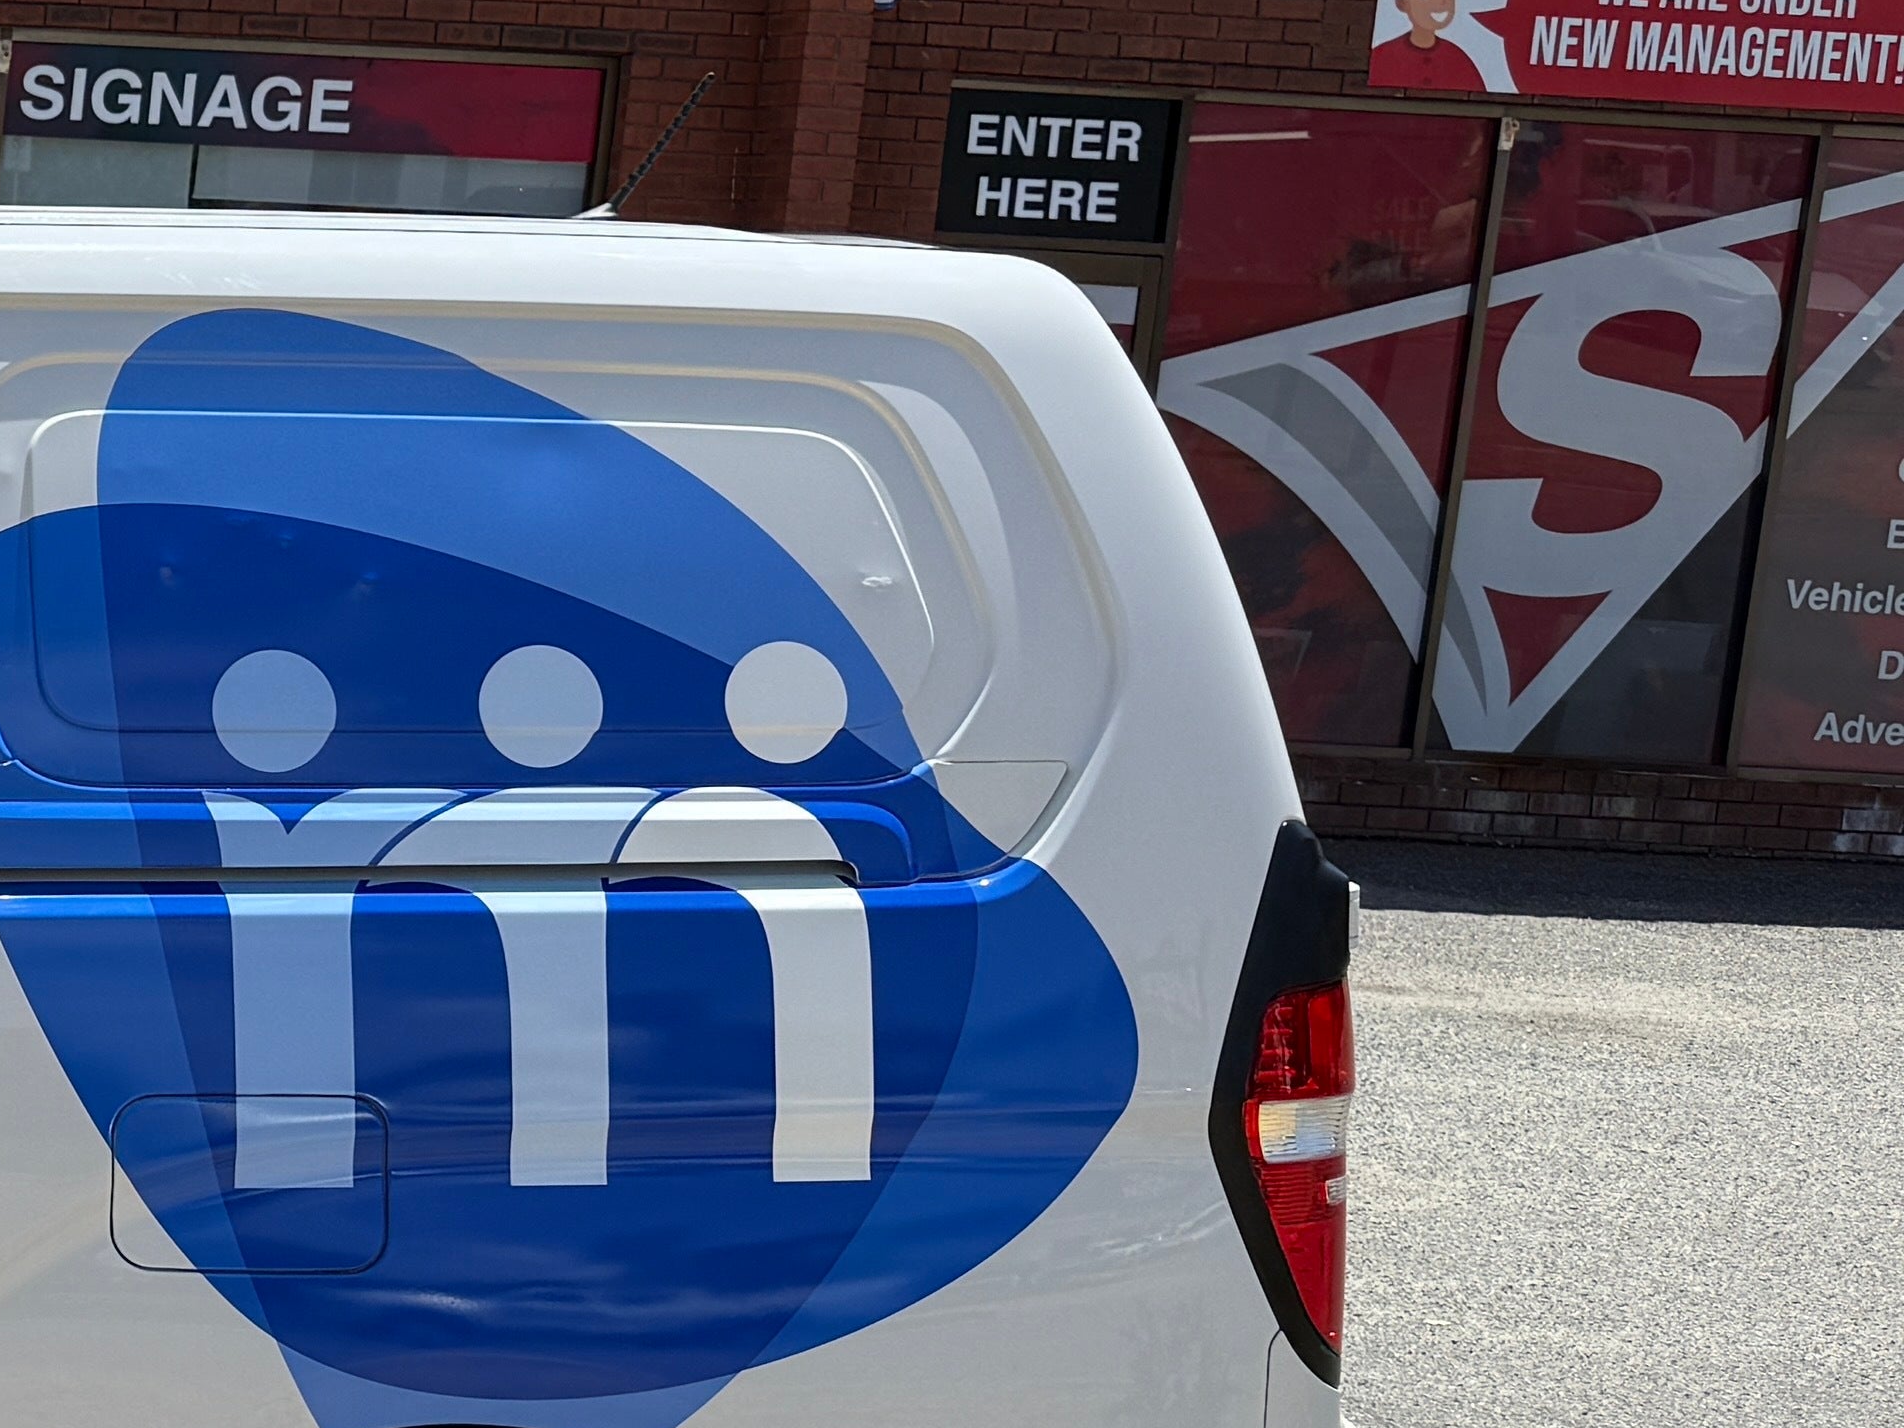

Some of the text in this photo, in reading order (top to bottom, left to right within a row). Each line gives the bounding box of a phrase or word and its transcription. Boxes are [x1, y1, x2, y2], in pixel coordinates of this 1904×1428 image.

[1530, 16, 1904, 84] NEW MANAGEMENT!
[19, 62, 353, 134] SIGNAGE
[967, 114, 1141, 161] ENTER
[976, 177, 1119, 222] HERE
